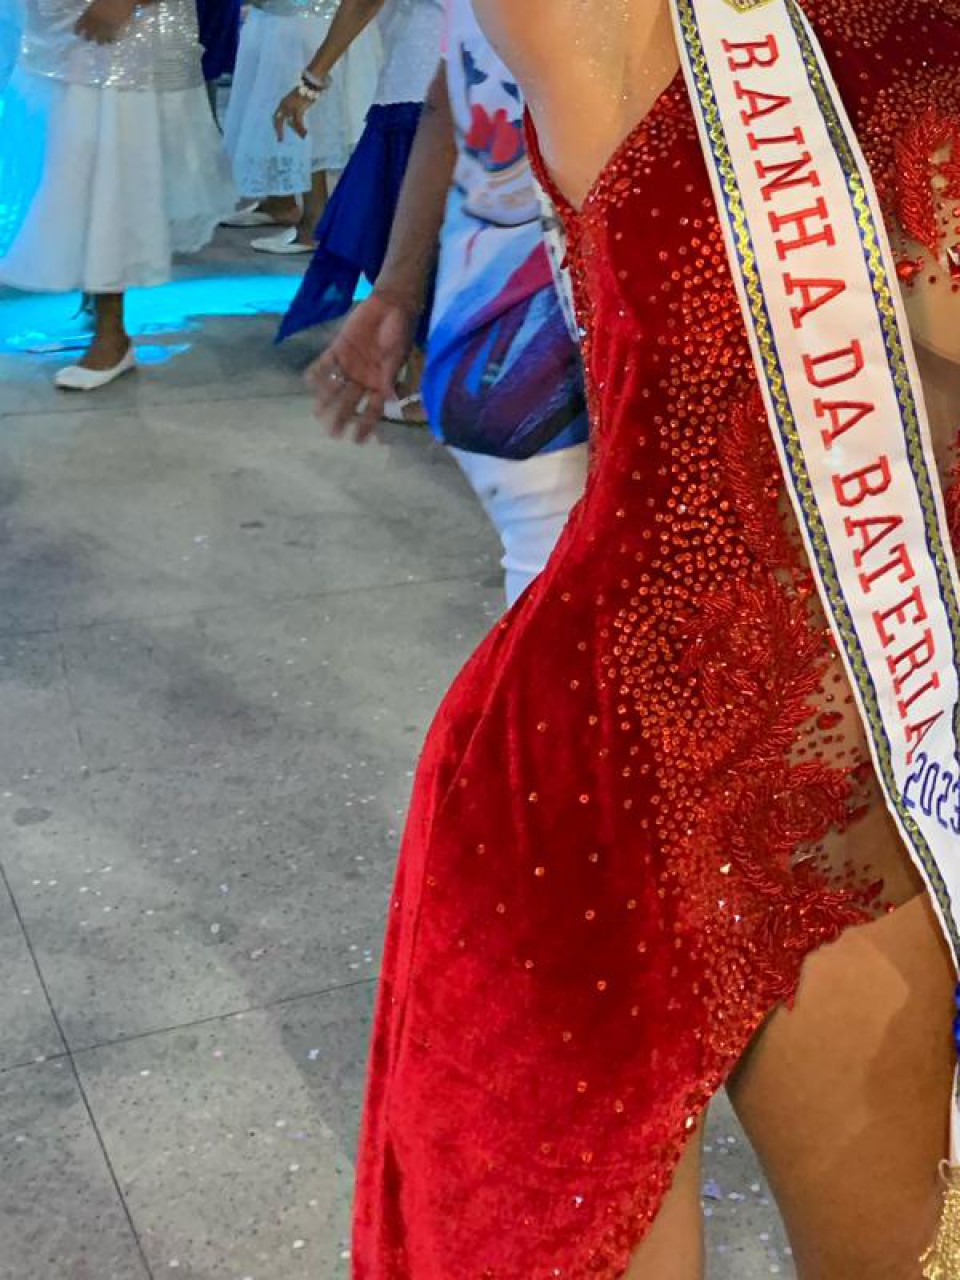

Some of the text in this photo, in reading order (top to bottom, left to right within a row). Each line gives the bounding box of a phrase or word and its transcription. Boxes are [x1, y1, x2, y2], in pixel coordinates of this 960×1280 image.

[720, 32, 946, 766] RAINHA DA BATERIA
